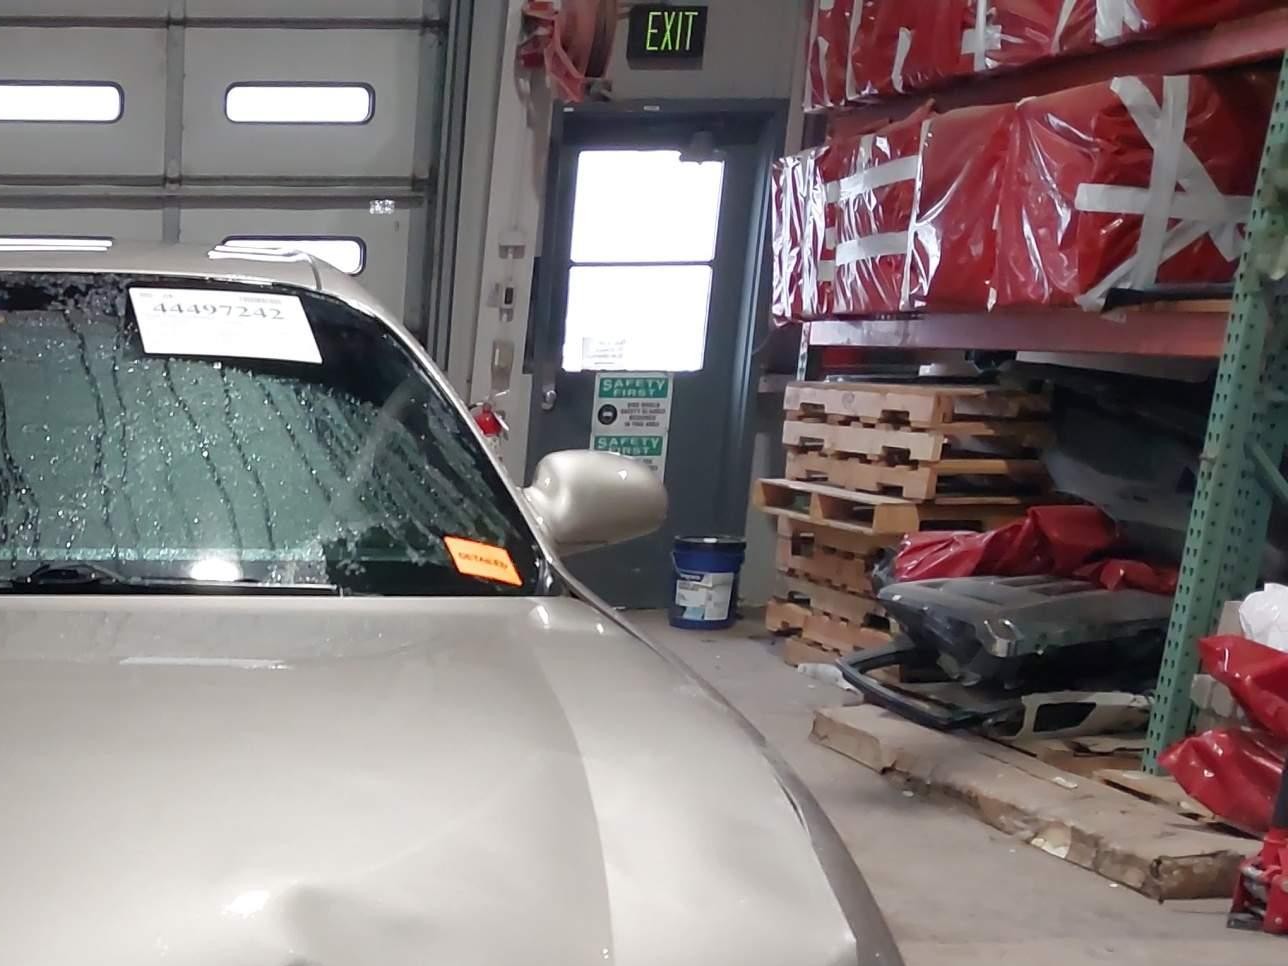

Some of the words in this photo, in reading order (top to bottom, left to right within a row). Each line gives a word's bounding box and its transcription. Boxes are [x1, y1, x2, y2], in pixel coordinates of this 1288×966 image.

[646, 11, 698, 50] EXIT
[153, 303, 285, 320] 44497242
[602, 379, 666, 391] SAFETY
[612, 388, 656, 397] FIRST
[597, 437, 660, 449] SAFETY
